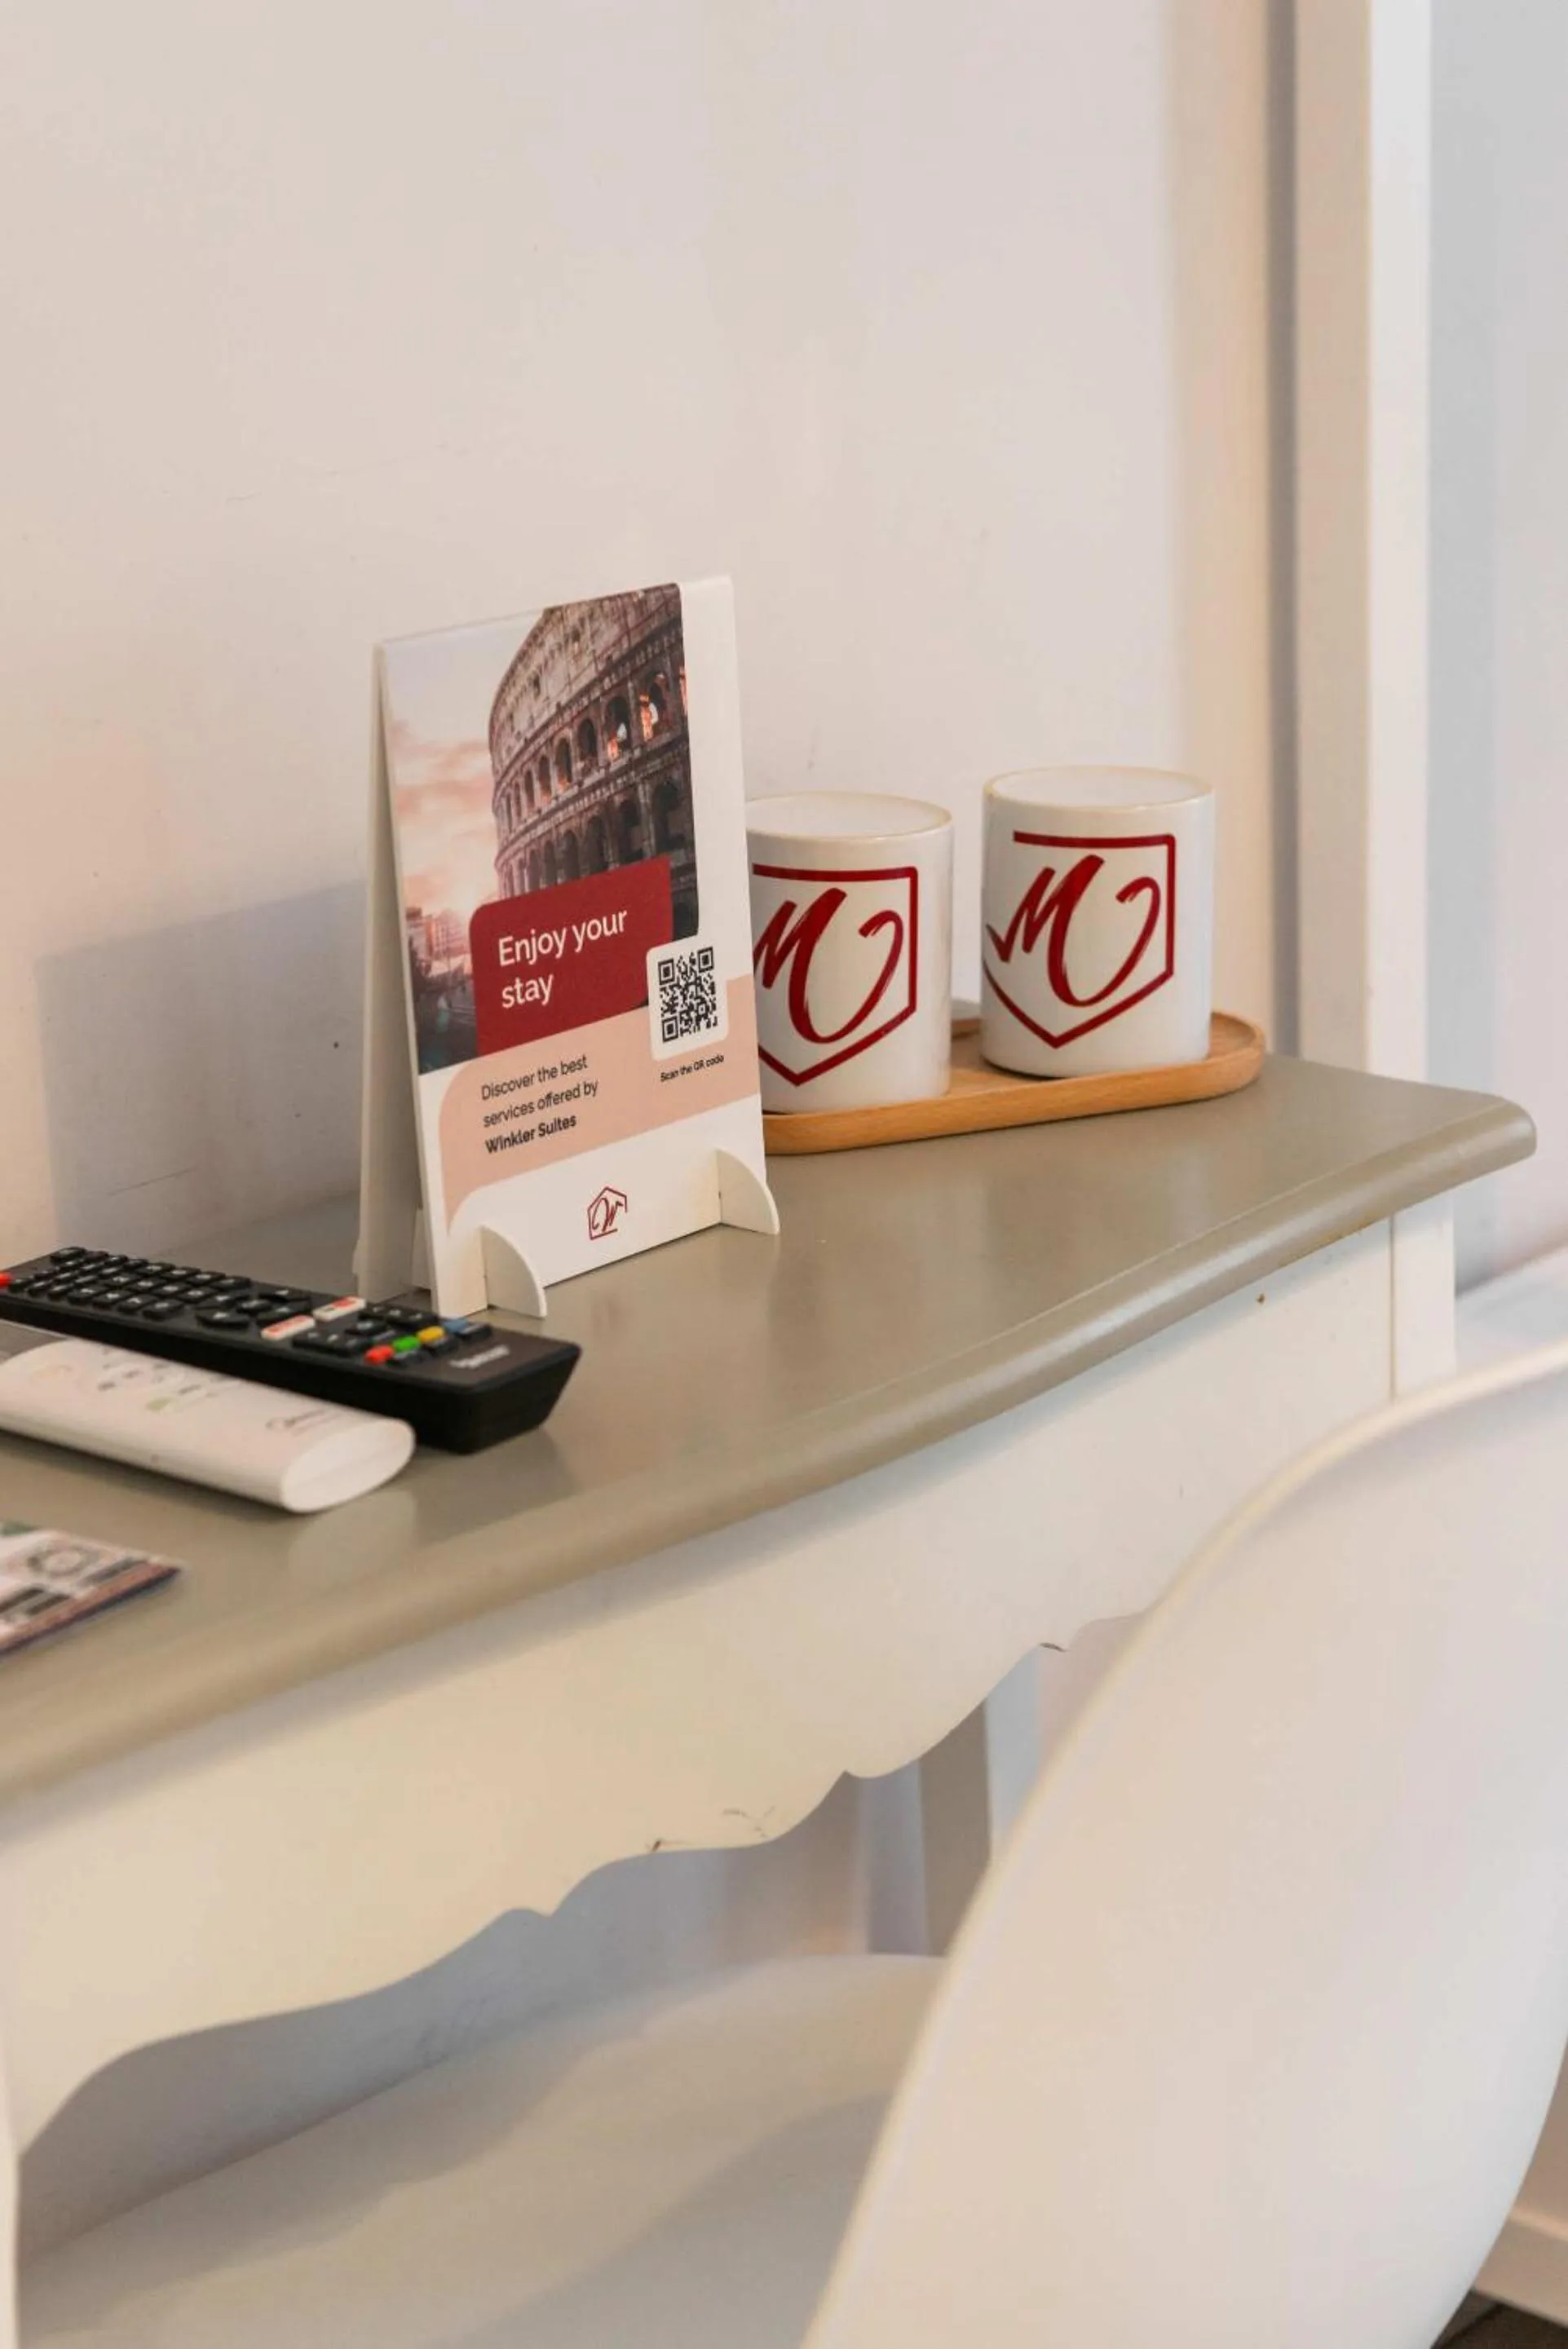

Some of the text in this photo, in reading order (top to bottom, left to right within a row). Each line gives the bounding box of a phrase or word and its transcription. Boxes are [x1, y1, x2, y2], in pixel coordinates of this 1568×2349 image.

[498, 910, 627, 966] Enjoy your
[501, 974, 554, 1009] stay
[481, 1054, 587, 1100] Discover the best
[660, 1054, 724, 1082] Scan the QR code
[483, 1080, 598, 1128] services offered by
[485, 1115, 576, 1154] Winkler Suites
